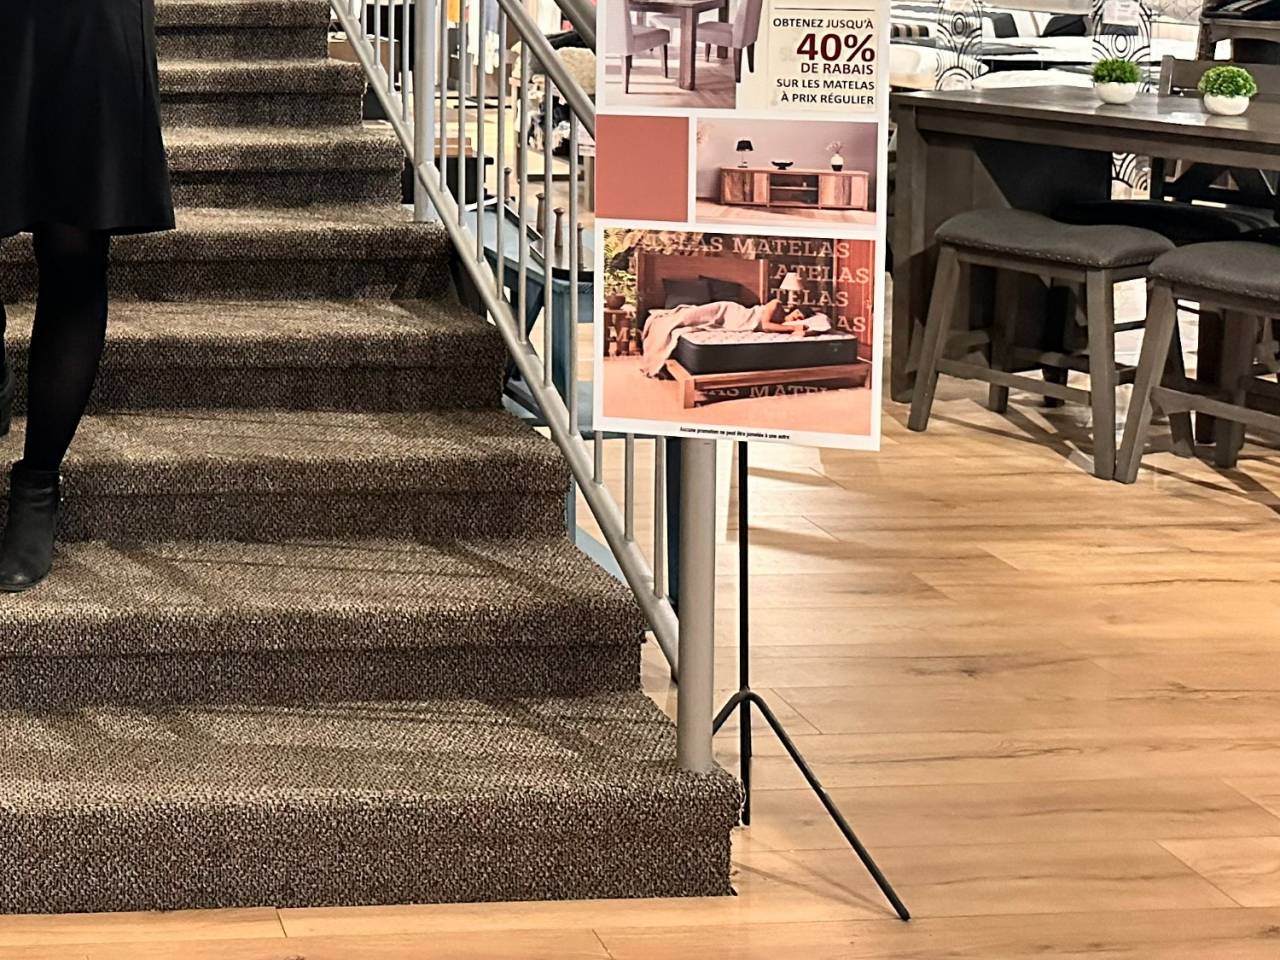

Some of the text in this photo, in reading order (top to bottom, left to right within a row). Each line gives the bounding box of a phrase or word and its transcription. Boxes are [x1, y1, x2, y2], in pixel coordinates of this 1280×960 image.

[773, 18, 874, 29] OBTENEZ JUSQU'À
[796, 33, 875, 62] 40%
[801, 62, 874, 75] DE RABAIS
[776, 79, 875, 90] SUR LES MATELAS
[781, 91, 874, 104] À PRIX RÉGULIER
[732, 237, 850, 258] MATELAS
